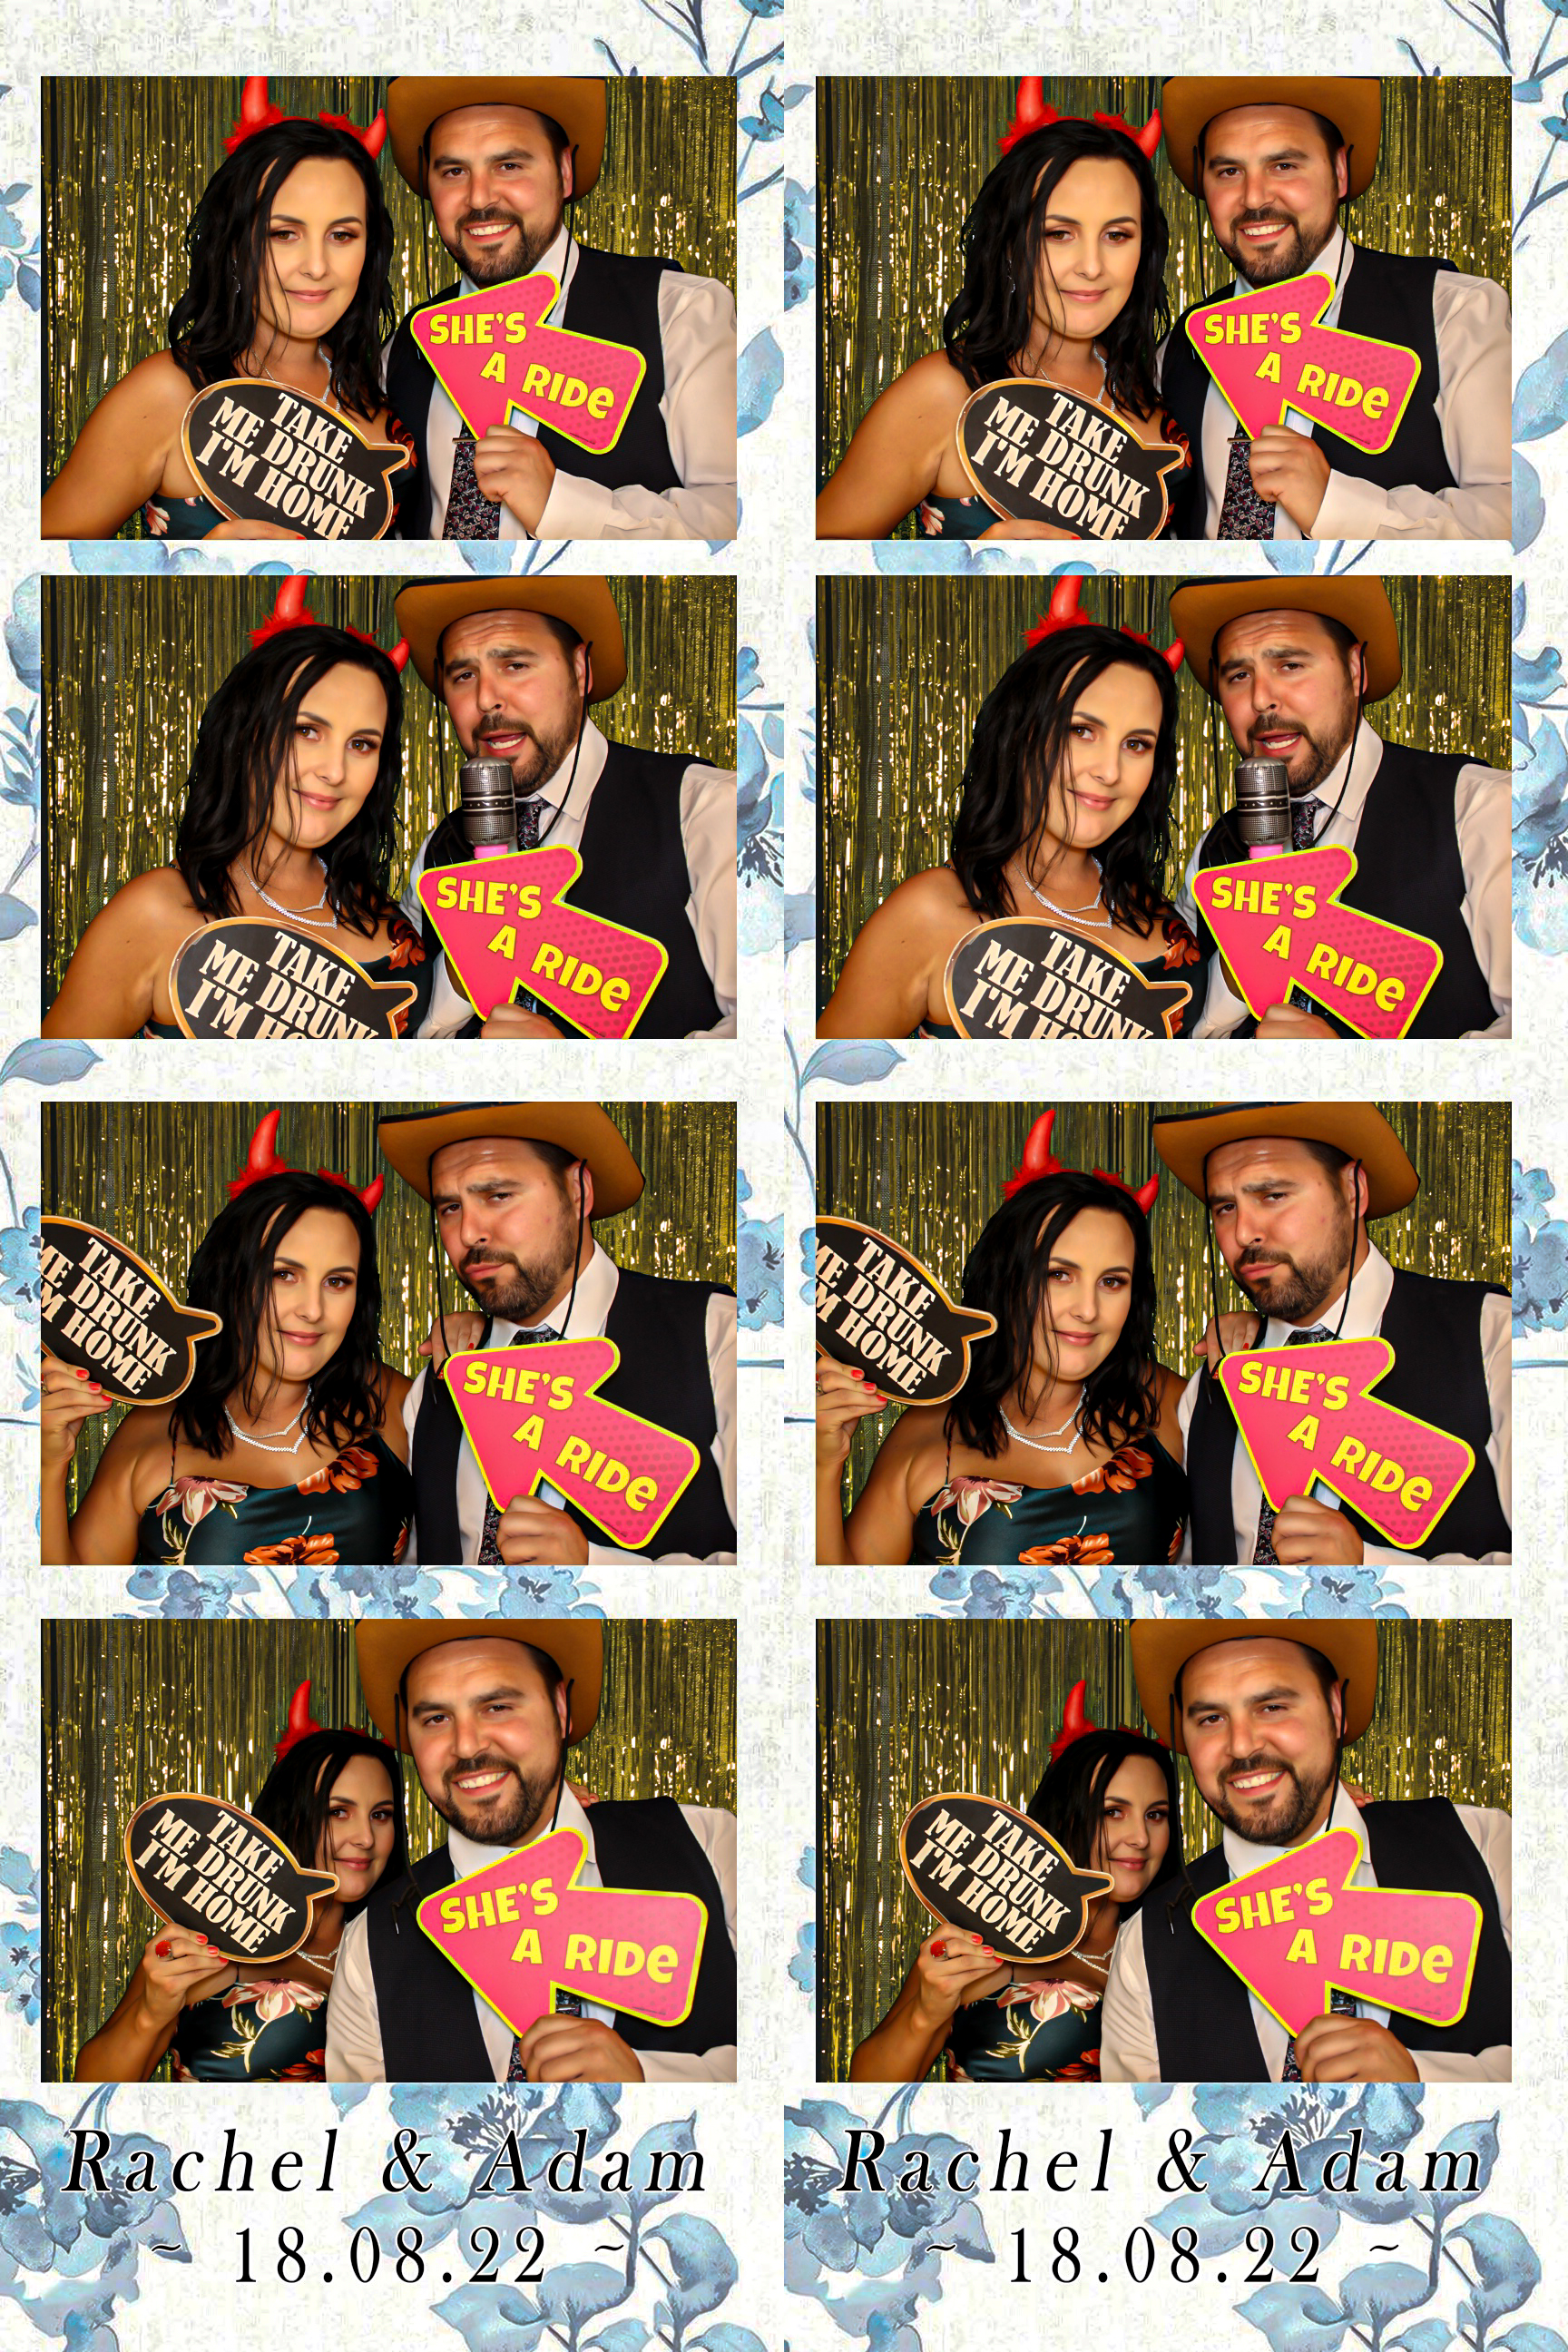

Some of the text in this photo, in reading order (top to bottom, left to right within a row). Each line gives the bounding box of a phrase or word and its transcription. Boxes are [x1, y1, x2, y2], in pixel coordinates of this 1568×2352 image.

[429, 311, 527, 345] SHE'S
[1204, 311, 1302, 345] SHE'S
[479, 351, 506, 384] A
[1254, 351, 1281, 384] A
[195, 429, 260, 488] I'M
[209, 396, 376, 519] ME DRUNK
[270, 392, 353, 465] TAKE
[970, 429, 1034, 488] I'M
[984, 396, 1151, 519] ME DRUNK
[1045, 392, 1128, 465] TAKE
[436, 876, 542, 919] SHE'S
[1210, 876, 1317, 919] SHE'S
[199, 938, 260, 996] ME
[265, 930, 357, 1007] TAKE
[486, 924, 517, 961] A
[974, 938, 1035, 996] ME
[1040, 930, 1132, 1007] TAKE
[1261, 924, 1292, 961] A
[184, 978, 254, 1039] I'M
[959, 978, 1029, 1039] I'M
[78, 1237, 162, 1320] TAKE
[853, 1237, 936, 1320] TAKE
[61, 1308, 152, 1395] HOME
[68, 1273, 177, 1377] DRUNK
[836, 1308, 927, 1395] HOME
[843, 1273, 952, 1377] DRUNK
[463, 1360, 575, 1411] SHE'S
[1238, 1360, 1350, 1411] SHE'S
[512, 1414, 545, 1452] A
[1287, 1414, 1320, 1452] A
[149, 1808, 297, 1935] ME DRUNK
[206, 1809, 285, 1884] TAKE
[924, 1808, 1072, 1935] ME DRUNK
[981, 1809, 1060, 1884] TAKE
[134, 1838, 271, 1954] I'M HOME
[439, 1877, 559, 1934] SHE'S
[909, 1838, 1046, 1954] I'M HOME
[1214, 1877, 1334, 1934] SHE'S
[510, 1928, 544, 1965] A
[1285, 1928, 1318, 1965] A
